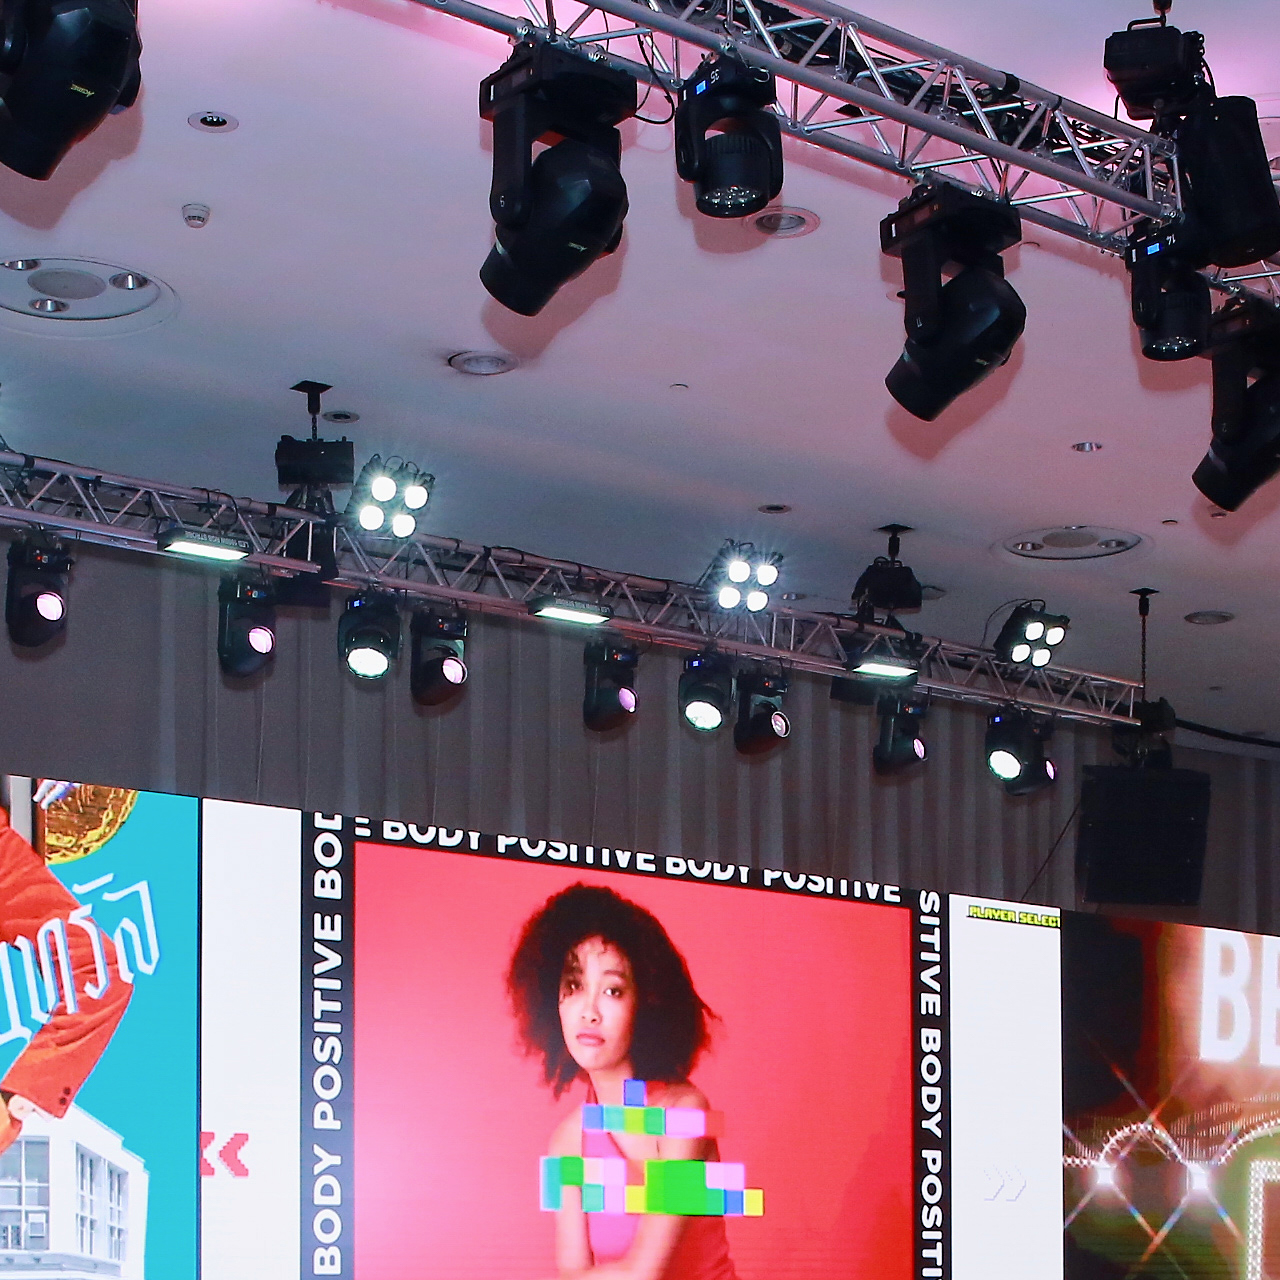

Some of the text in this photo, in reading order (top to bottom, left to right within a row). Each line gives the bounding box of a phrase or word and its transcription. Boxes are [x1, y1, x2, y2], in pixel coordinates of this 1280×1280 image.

[920, 889, 942, 1017] SITIVE
[968, 905, 1016, 922] PLAYER
[313, 912, 343, 1130] POSITIVE
[921, 1027, 942, 1139] BODY
[313, 1144, 343, 1275] BODY
